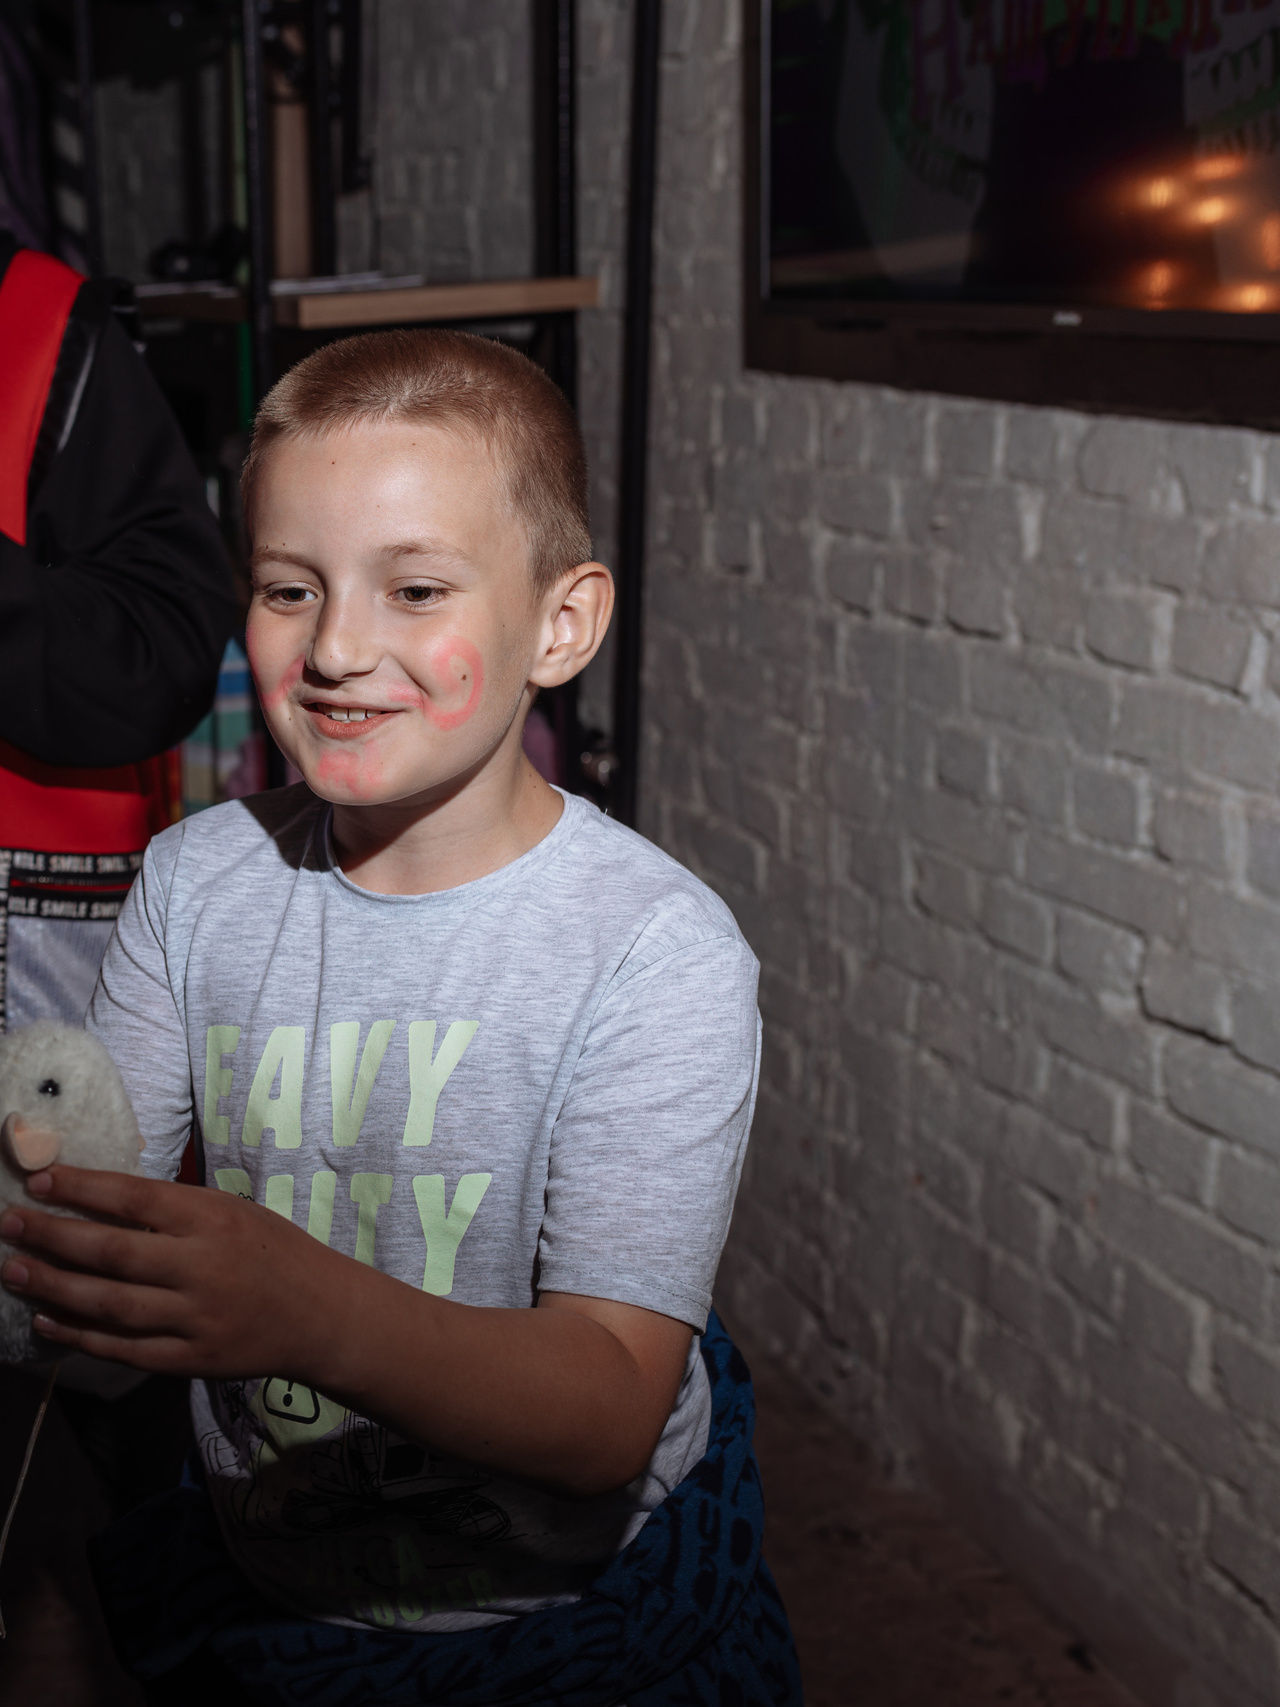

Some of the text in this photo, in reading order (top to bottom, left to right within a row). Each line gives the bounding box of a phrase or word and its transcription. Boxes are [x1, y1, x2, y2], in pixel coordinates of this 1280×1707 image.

[49, 855, 94, 873] SMILE
[41, 900, 87, 916] SMILE
[90, 902, 121, 918] SMI
[203, 1020, 480, 1149] EAVY
[306, 1533, 428, 1588] MEGA
